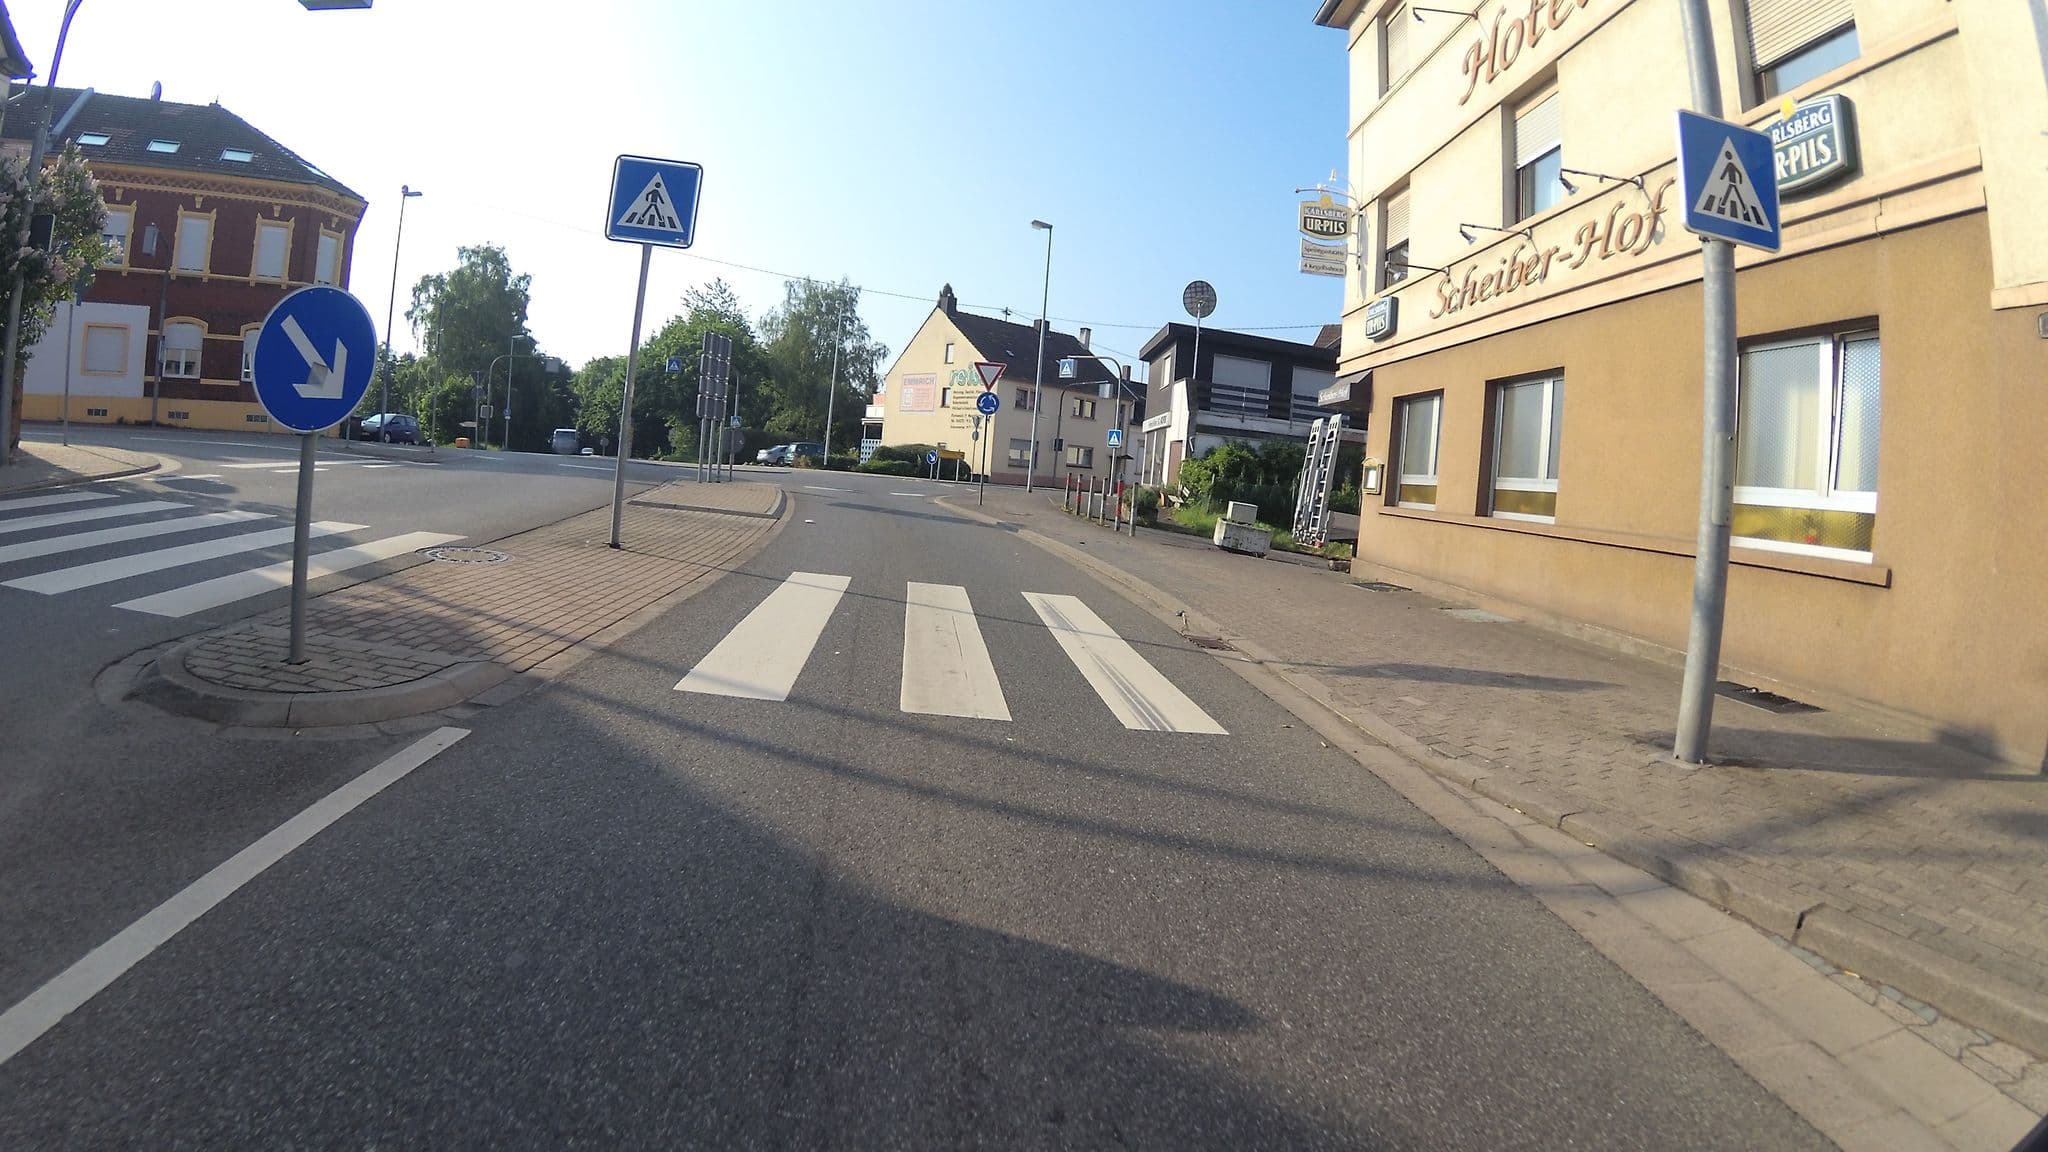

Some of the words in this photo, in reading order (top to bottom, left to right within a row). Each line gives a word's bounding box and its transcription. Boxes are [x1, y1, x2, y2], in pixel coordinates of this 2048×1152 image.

[1459, 0, 1589, 105] Hote
[1772, 106, 1831, 143] RLSBERG
[1775, 134, 1832, 180] R-PILS
[1304, 206, 1347, 219] KARLSBERG
[1306, 217, 1346, 234] UR-PILS
[1429, 177, 1677, 319] Scheiber-Hof
